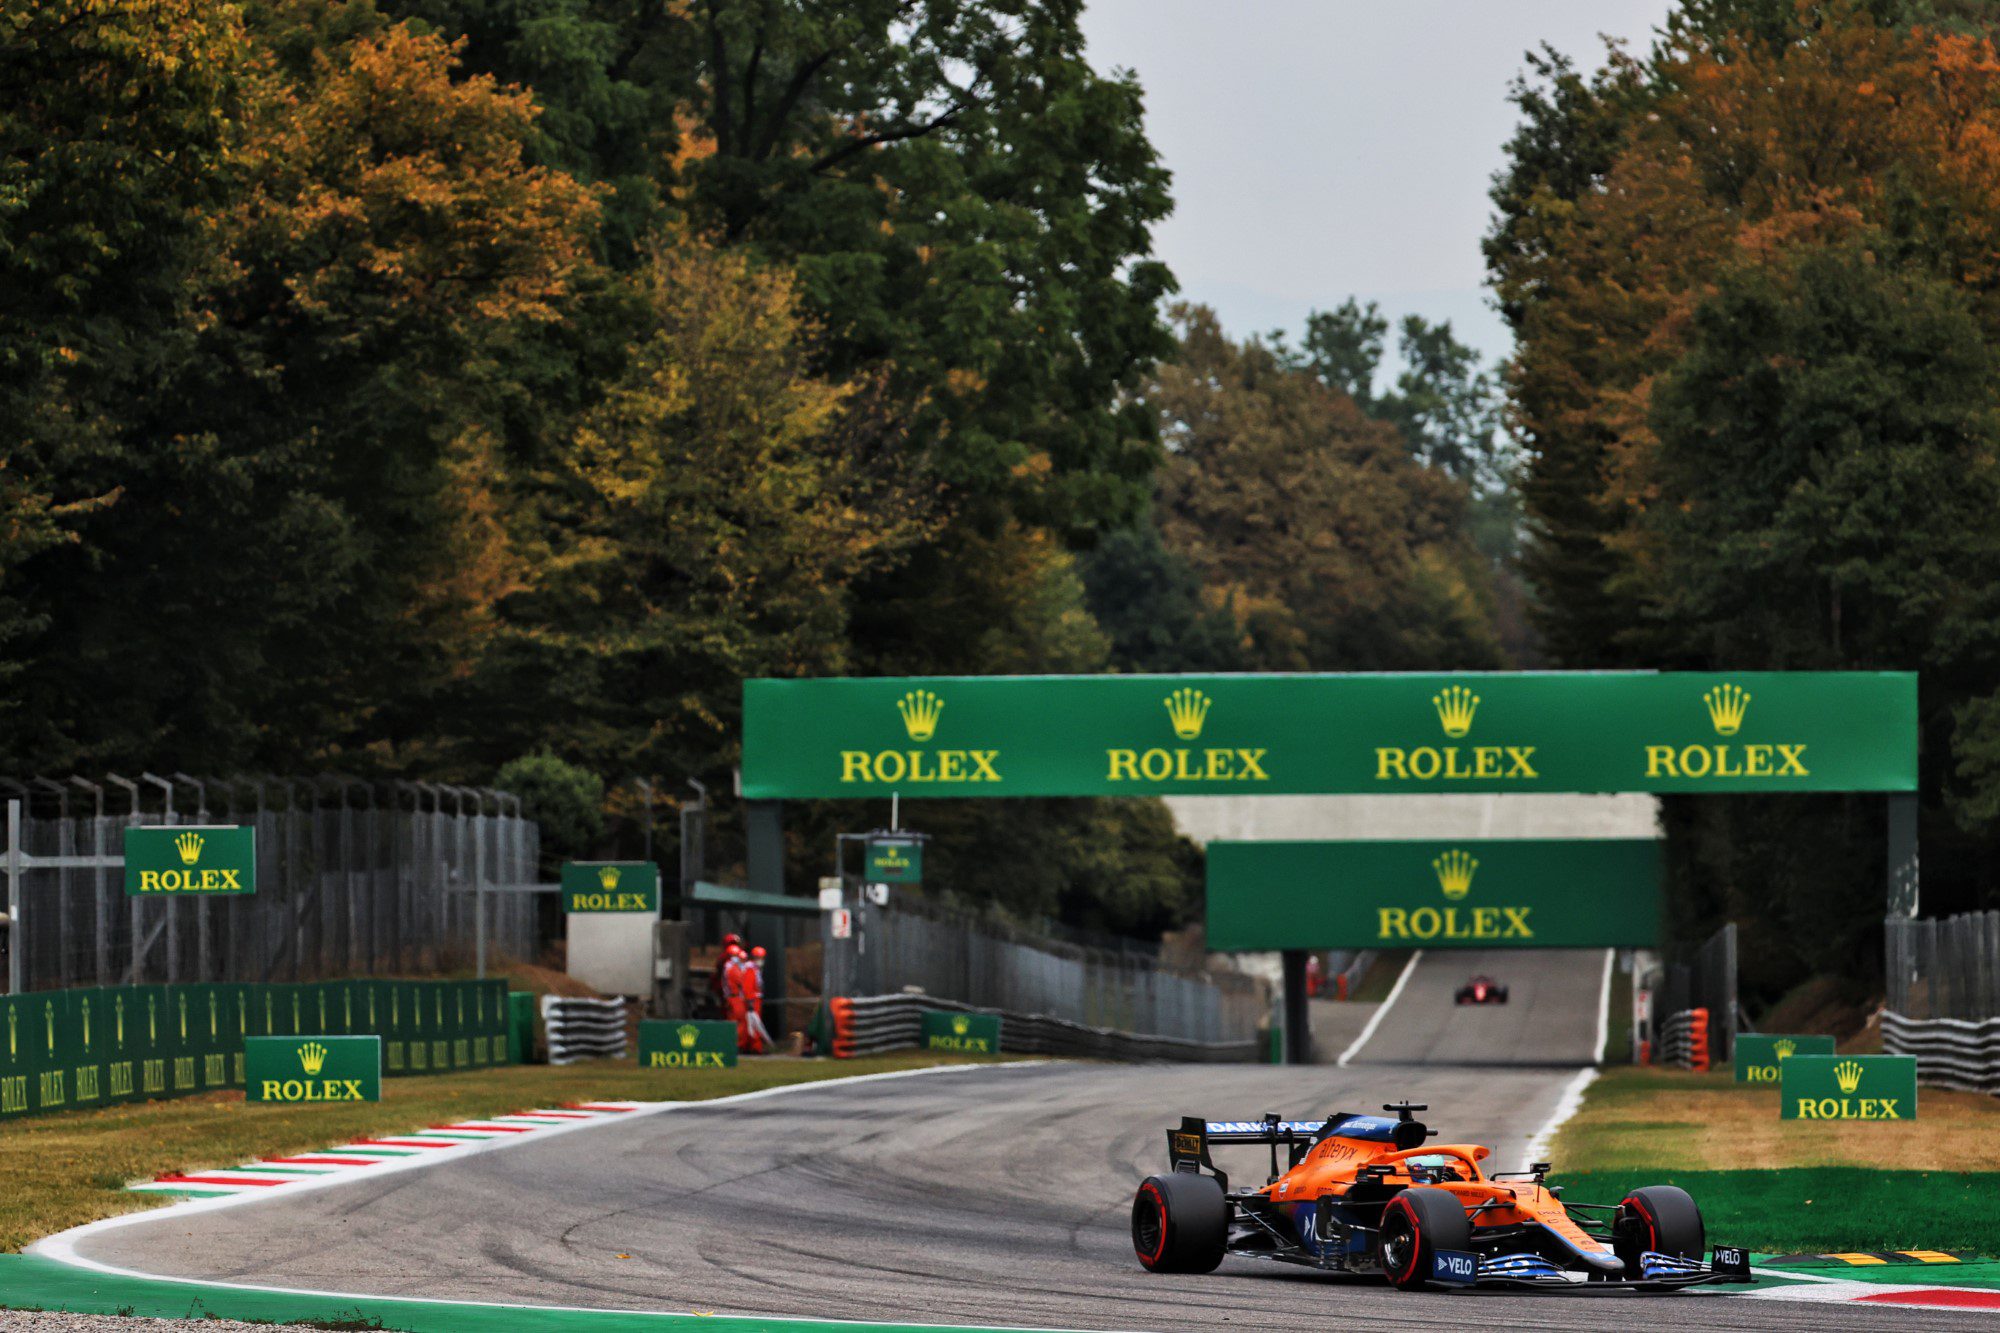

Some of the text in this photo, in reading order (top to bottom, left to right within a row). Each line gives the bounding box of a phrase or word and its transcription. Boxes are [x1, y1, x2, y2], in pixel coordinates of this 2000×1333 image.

[841, 750, 1002, 782] ROLEX
[1106, 748, 1268, 780] ROLEX
[1375, 747, 1538, 779] ROLEX
[1645, 745, 1809, 778] ROLEX
[140, 869, 241, 891] ROLEX
[573, 893, 647, 910] ROLEX
[1378, 907, 1533, 939] ROLEX
[929, 1034, 989, 1054] ROLEX
[650, 1051, 724, 1068] ROLEX
[262, 1080, 364, 1102] ROLEX
[1797, 1098, 1900, 1120] ROLEX
[1318, 1138, 1358, 1163] alteryx
[1448, 1257, 1472, 1275] VELO
[1720, 1250, 1741, 1265] VELO
